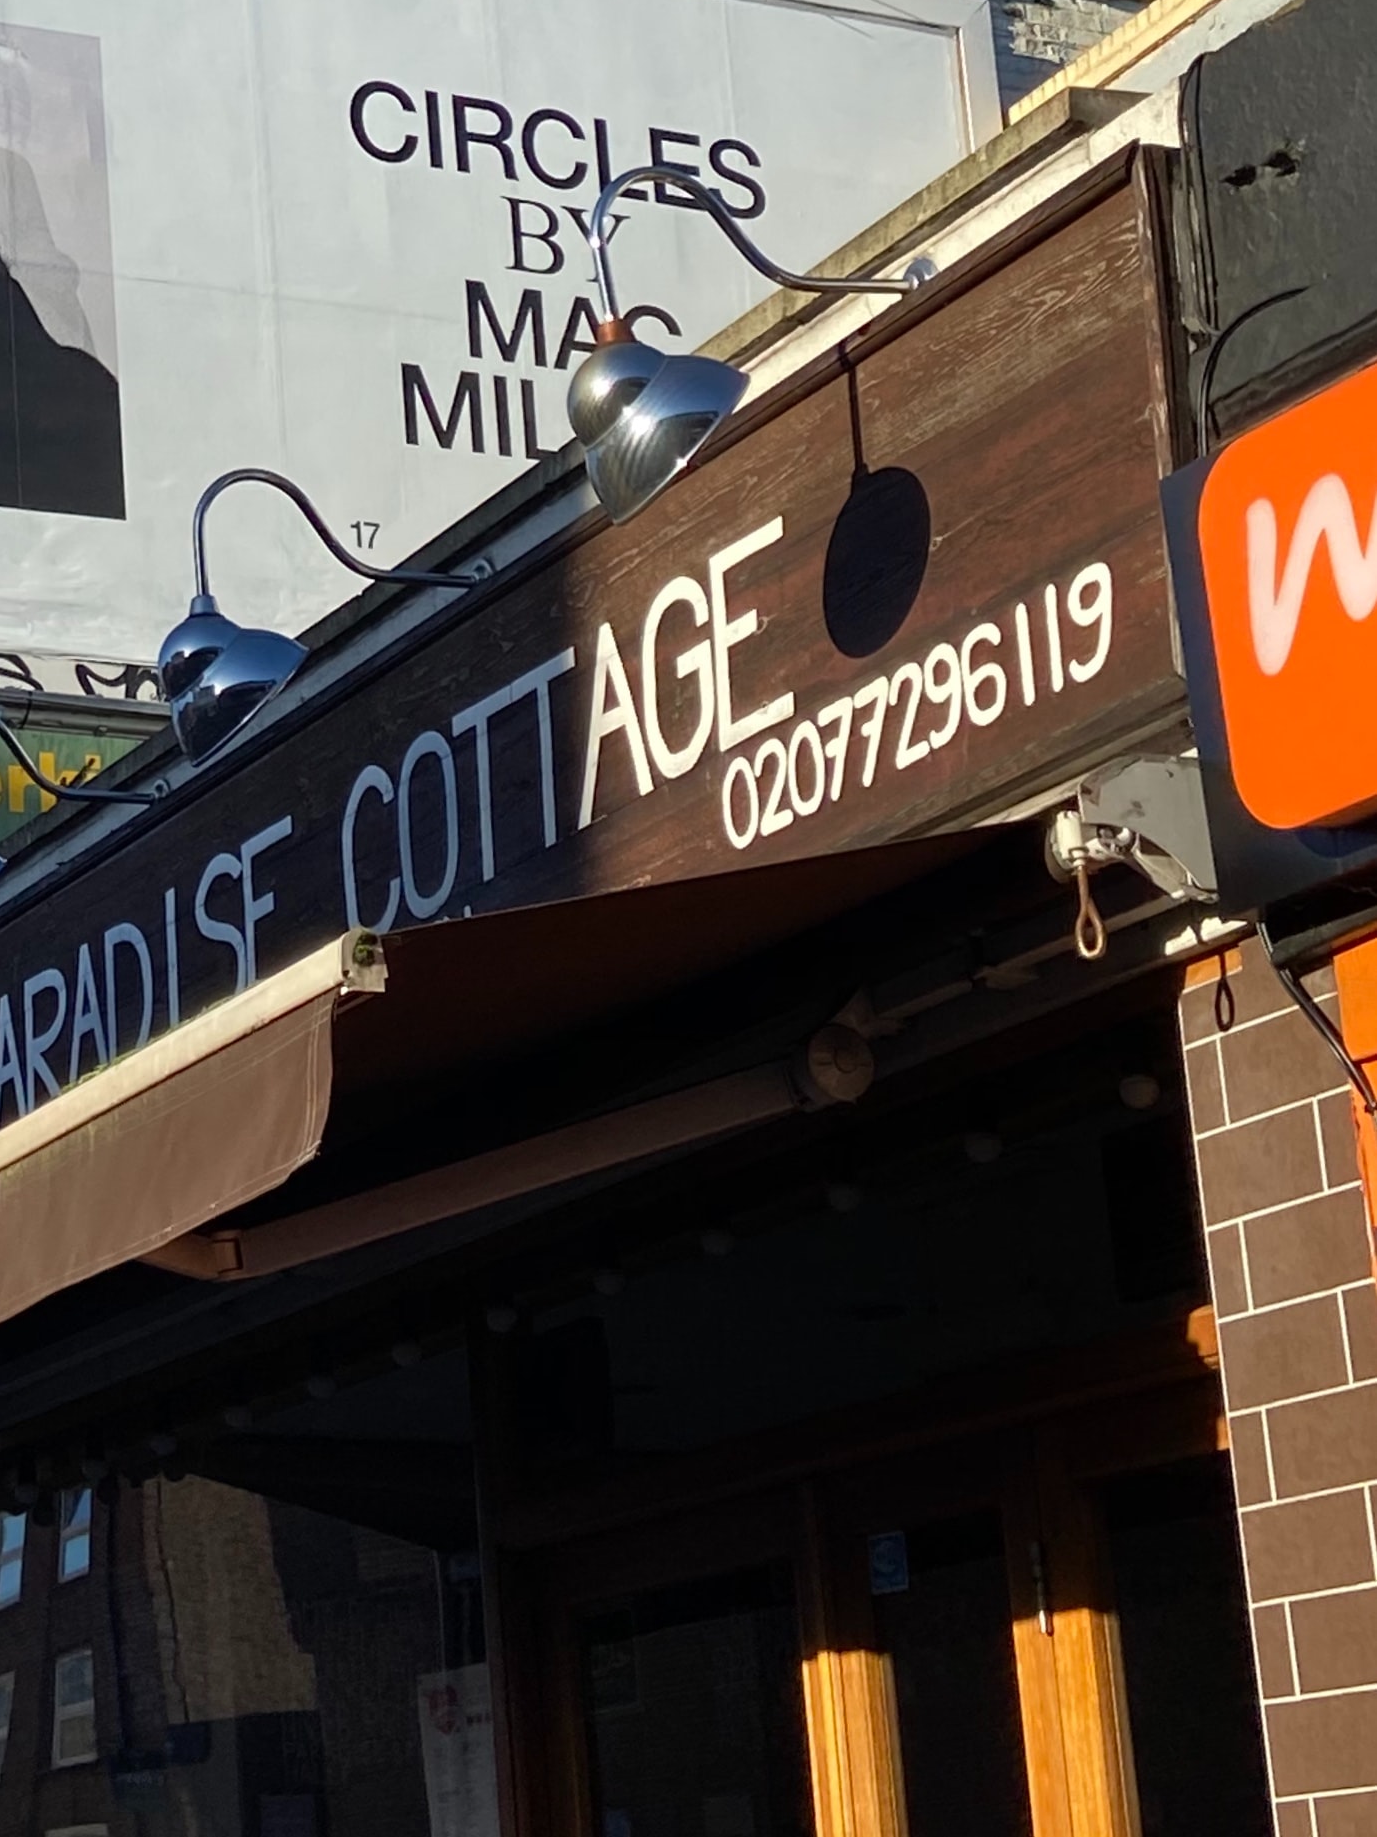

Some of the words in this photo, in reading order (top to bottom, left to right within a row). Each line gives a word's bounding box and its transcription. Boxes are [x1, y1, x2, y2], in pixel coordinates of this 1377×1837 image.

[349, 80, 766, 220] CIRCLES
[500, 196, 631, 283] BY
[401, 363, 560, 461] MIL
[350, 520, 381, 549] 17
[341, 516, 794, 935] COTTAGE
[722, 562, 1113, 850] 02077296119
